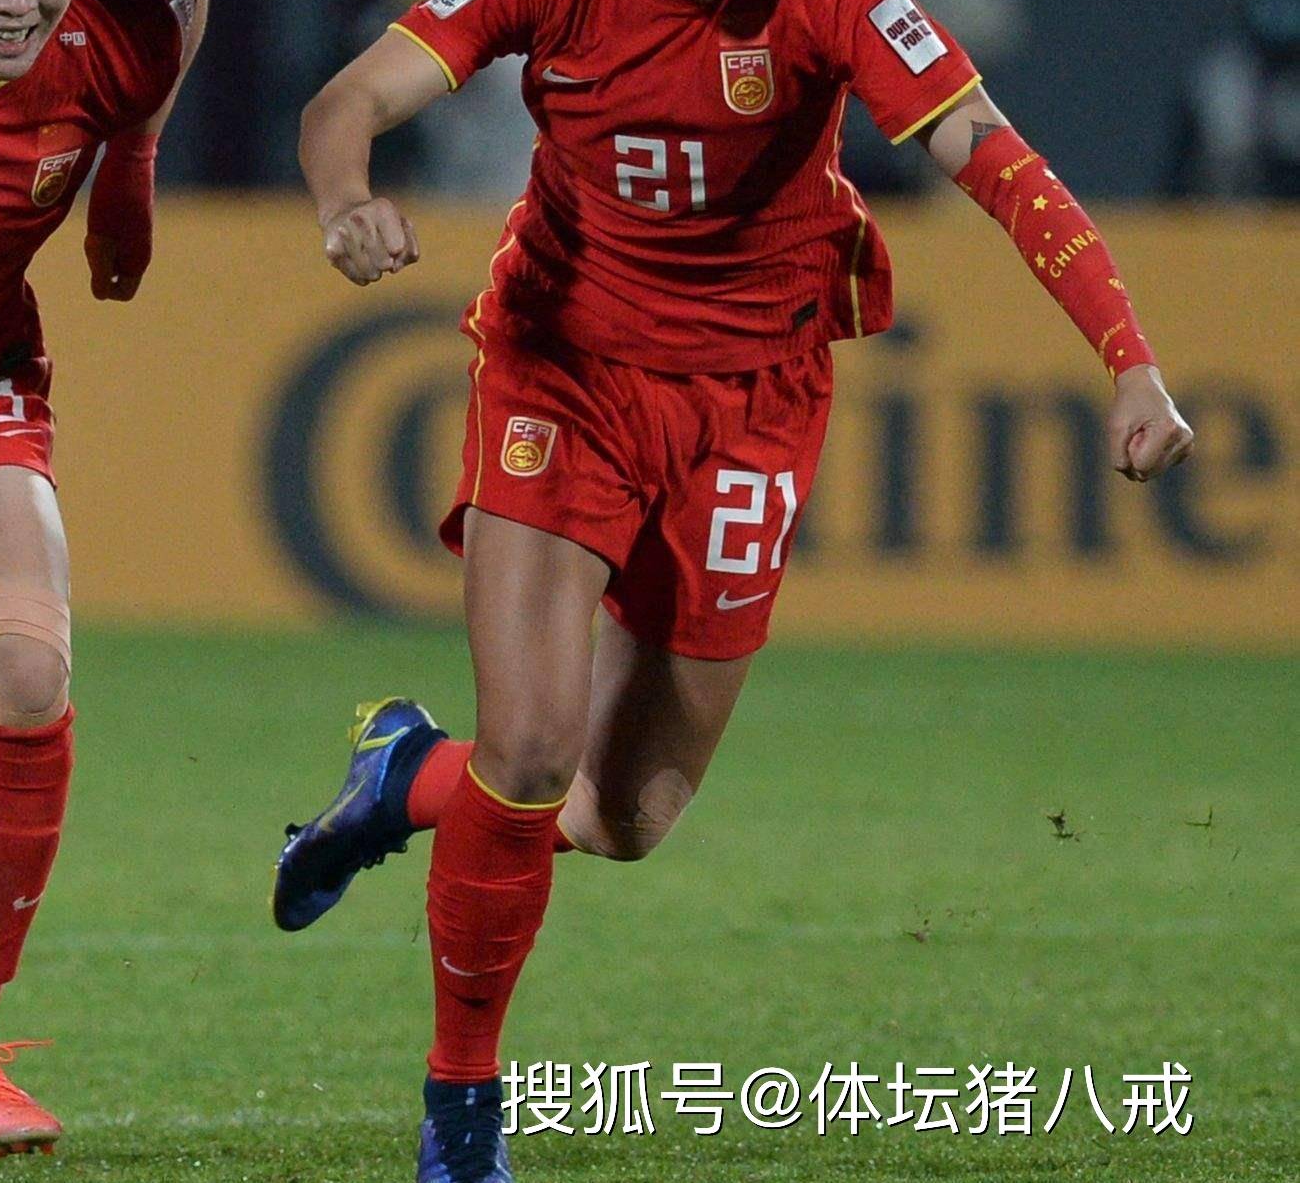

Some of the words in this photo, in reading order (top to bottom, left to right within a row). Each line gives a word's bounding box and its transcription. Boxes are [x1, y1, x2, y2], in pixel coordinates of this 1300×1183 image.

[886, 18, 910, 40] OUR
[900, 28, 924, 51] FOR
[727, 55, 765, 69] CFA
[615, 133, 707, 211] 21
[1050, 228, 1099, 279] CHINA
[513, 422, 550, 437] CFA
[706, 469, 798, 574] 21
